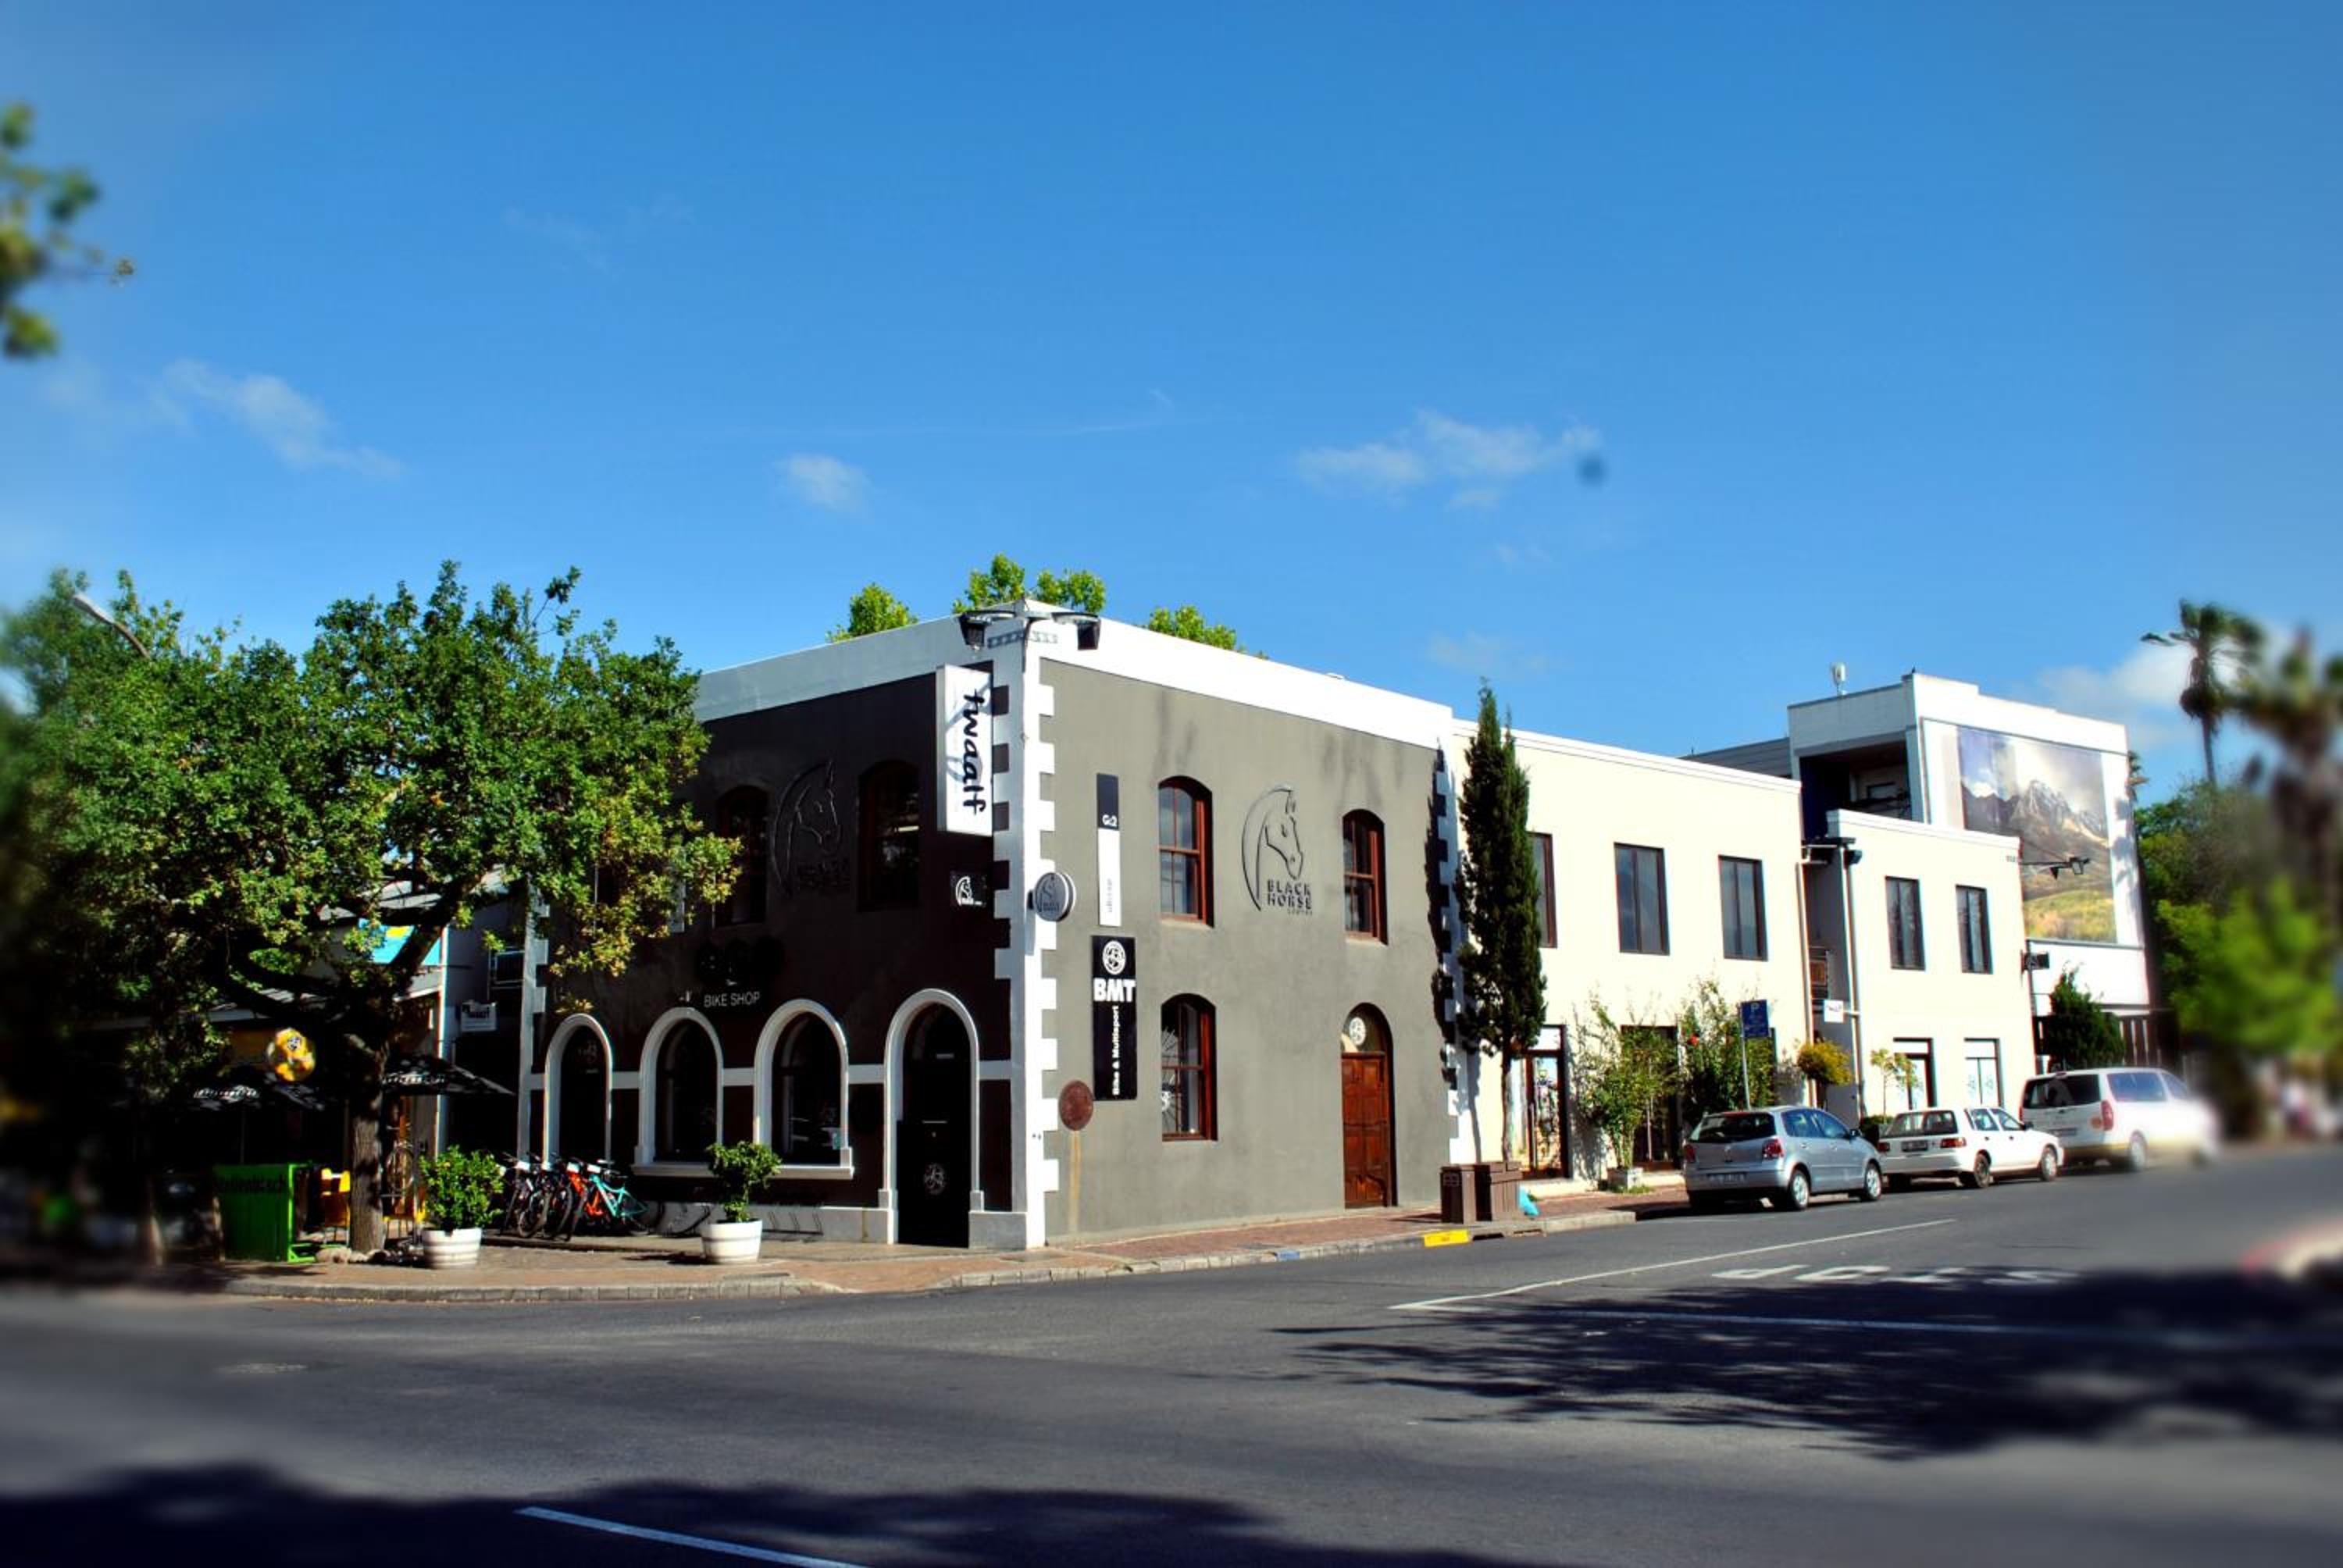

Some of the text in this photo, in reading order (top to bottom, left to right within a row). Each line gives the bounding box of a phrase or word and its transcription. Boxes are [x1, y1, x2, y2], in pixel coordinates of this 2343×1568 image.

[963, 689, 986, 815] twaalf
[1268, 879, 1311, 896] BLACK
[1268, 893, 1312, 910] HORSE
[1094, 978, 1136, 1003] BMT
[704, 991, 760, 1008] BIKE SHOP
